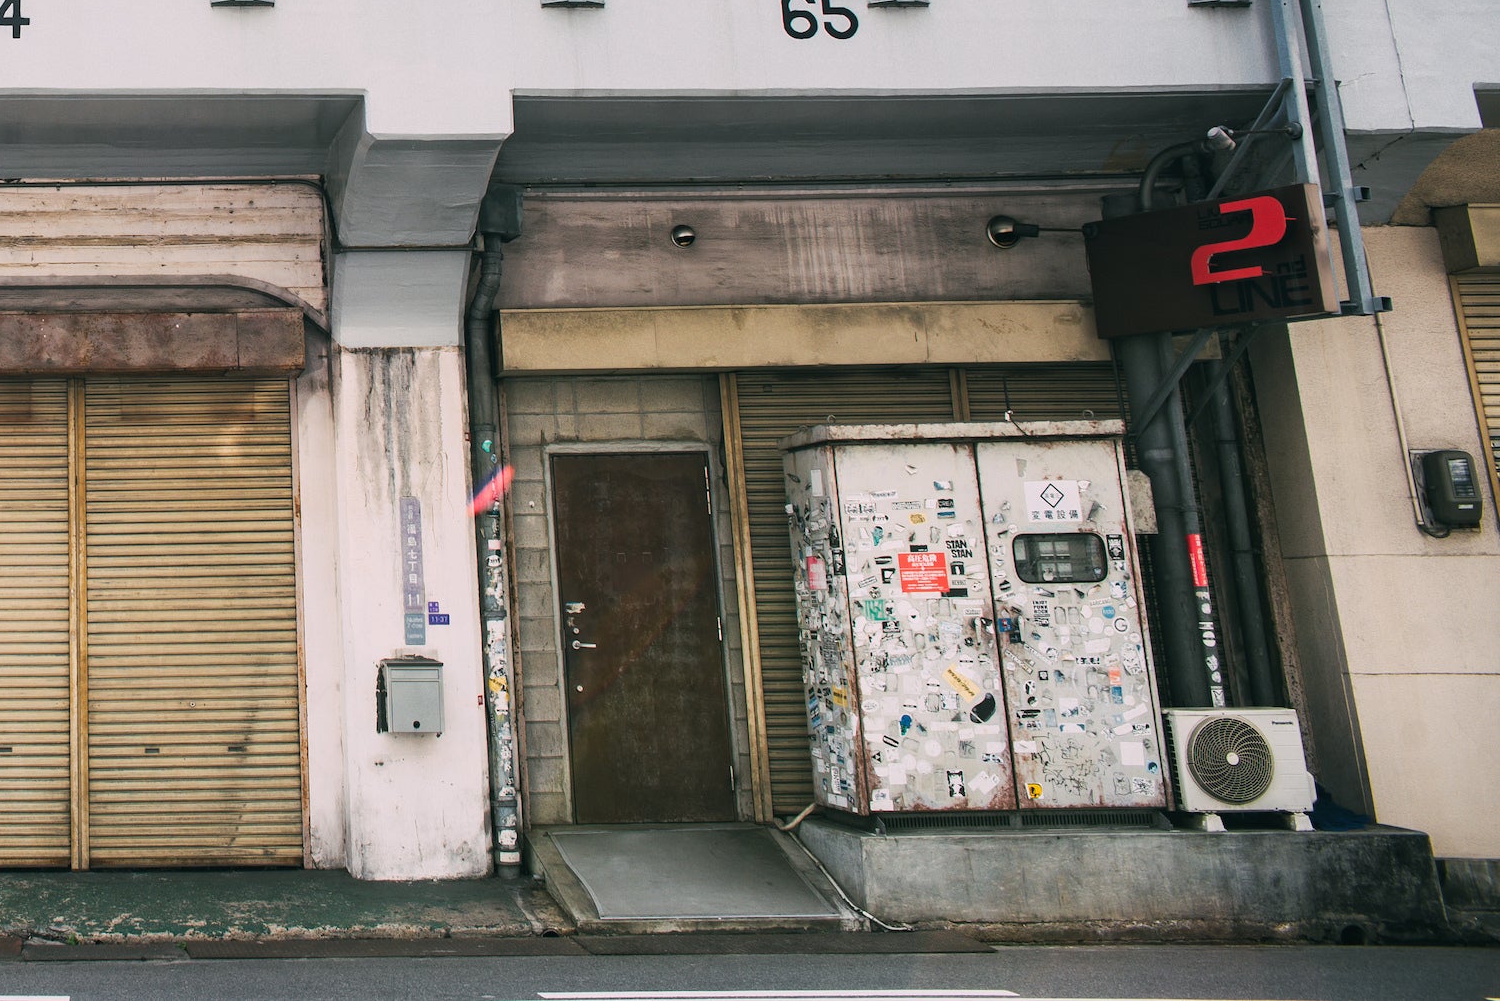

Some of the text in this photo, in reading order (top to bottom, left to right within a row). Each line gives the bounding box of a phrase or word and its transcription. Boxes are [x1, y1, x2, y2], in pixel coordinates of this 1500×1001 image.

[1209, 275, 1313, 316] LINE
[946, 539, 967, 549] STAN
[951, 549, 973, 558] STAN
